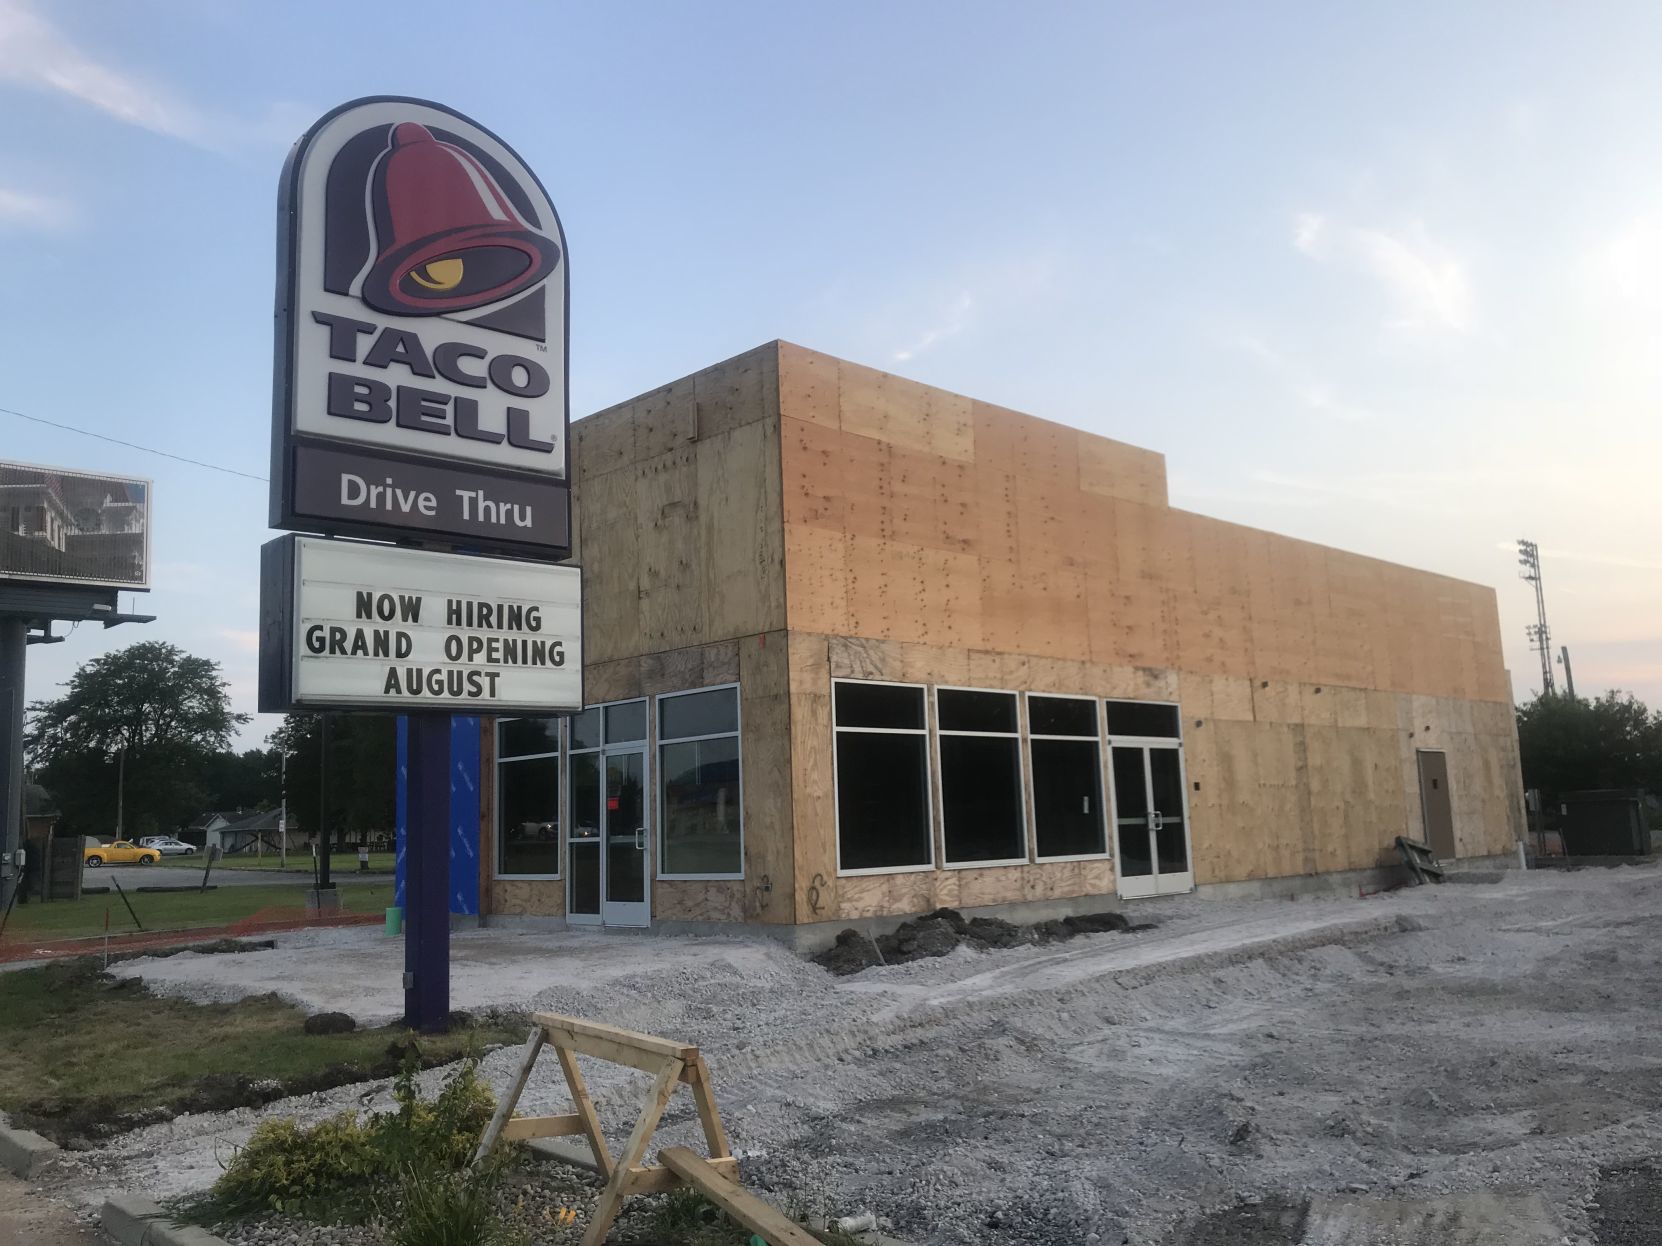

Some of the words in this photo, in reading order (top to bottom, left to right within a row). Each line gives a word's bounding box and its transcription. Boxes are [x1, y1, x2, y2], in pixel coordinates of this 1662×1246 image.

[311, 311, 551, 398] TACO
[327, 372, 555, 453] BELL
[340, 473, 437, 516] Drive
[455, 489, 532, 528] Thru
[355, 591, 422, 623] NOW
[446, 598, 542, 632] HIRING
[305, 624, 413, 659] GRAND
[444, 634, 565, 667] OPENING
[383, 666, 500, 698] AUGUST
